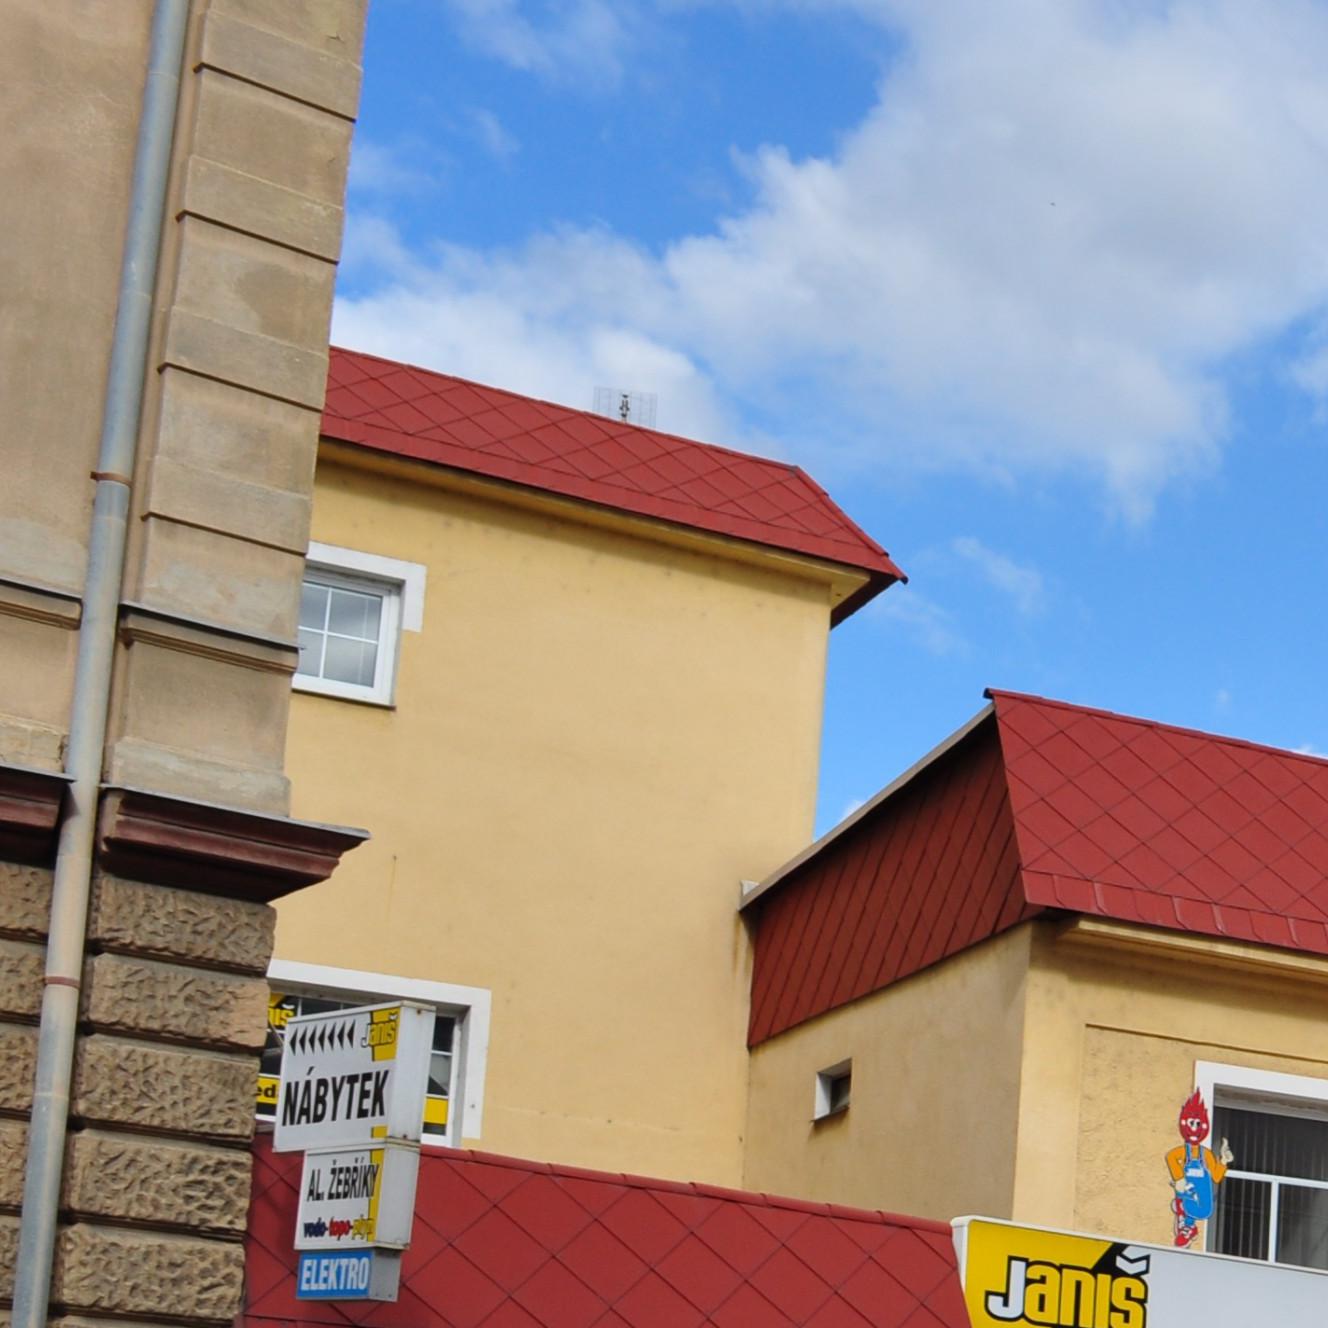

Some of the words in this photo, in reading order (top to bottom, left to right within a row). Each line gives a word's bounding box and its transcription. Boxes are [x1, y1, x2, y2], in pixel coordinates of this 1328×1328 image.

[361, 1013, 398, 1049] Janiš
[281, 1066, 389, 1127] NÁBYTEK
[328, 1157, 381, 1200] ŽEBŘÍKY
[300, 1257, 371, 1292] ELEKTRO
